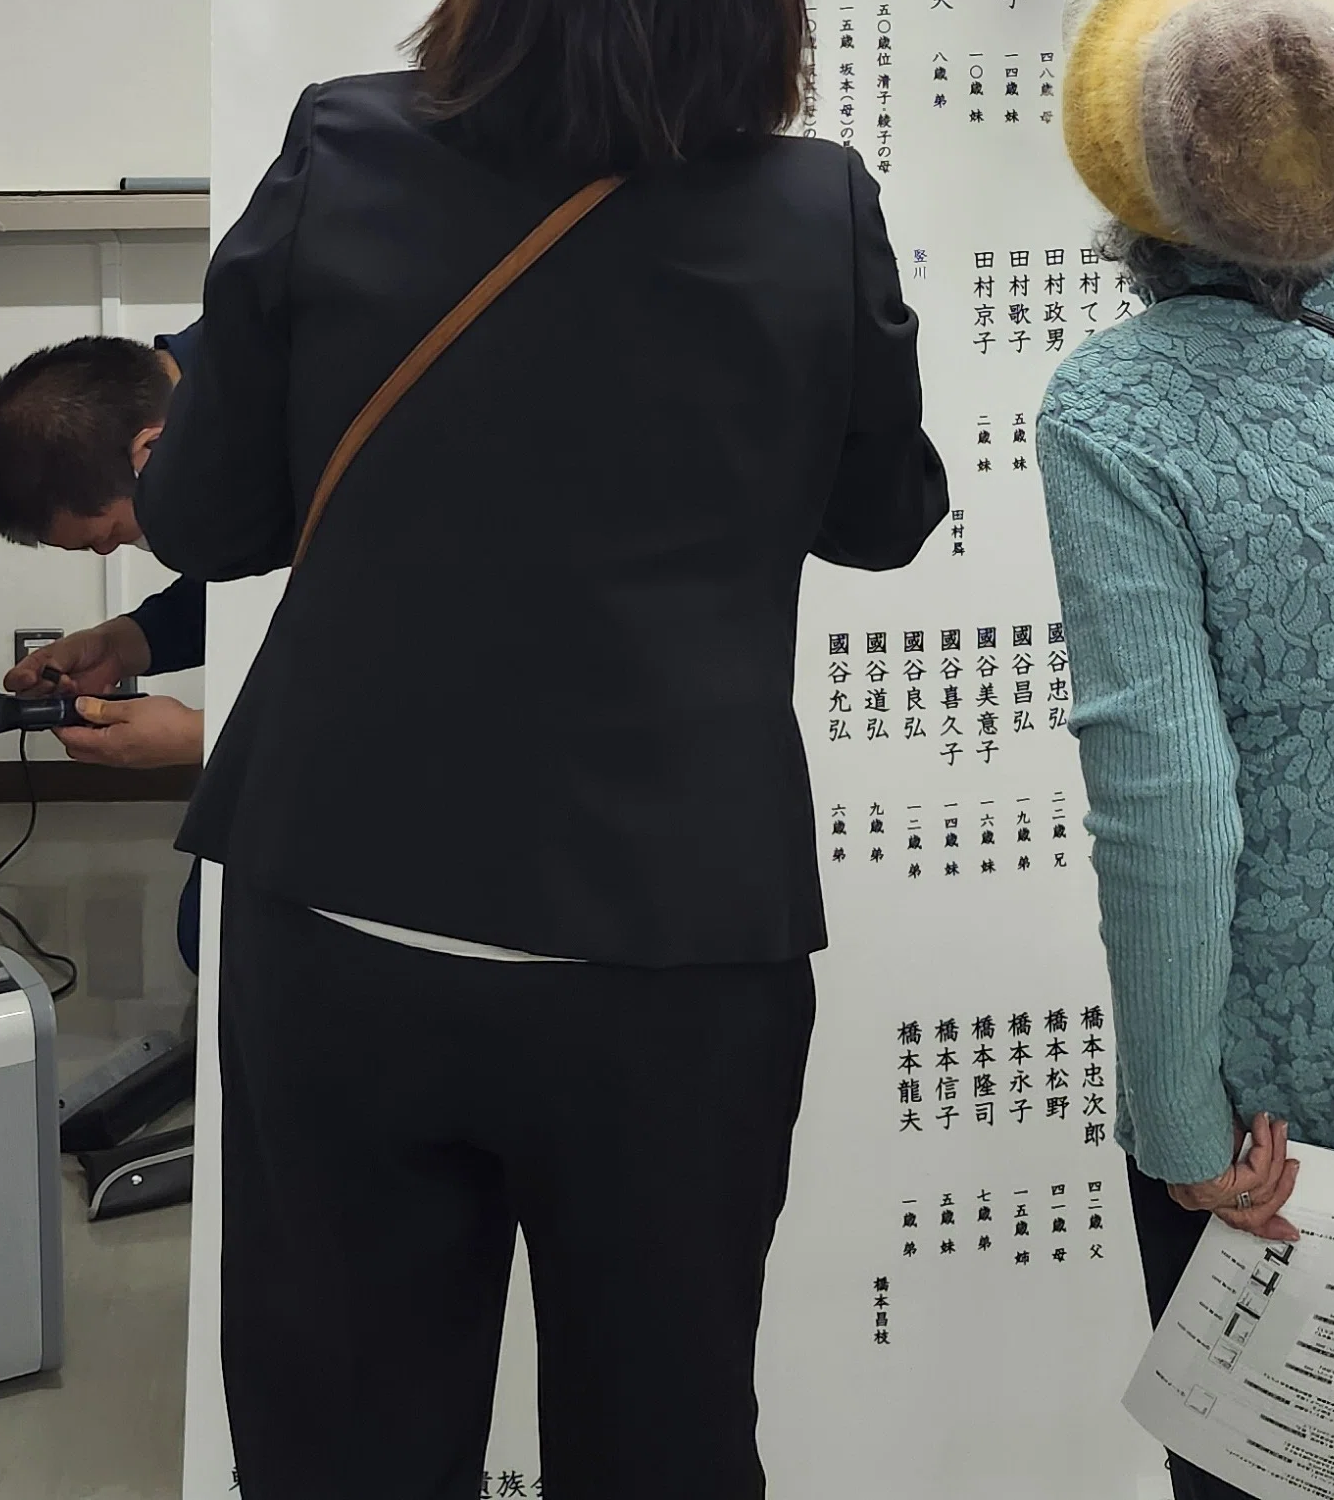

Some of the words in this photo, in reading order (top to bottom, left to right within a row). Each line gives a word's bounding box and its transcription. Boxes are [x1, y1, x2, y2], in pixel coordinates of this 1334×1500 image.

[973, 252, 996, 354] 田村京子
[1008, 251, 1031, 353] 田村歌子
[1043, 249, 1067, 351] 田村政男
[828, 633, 852, 741] 國谷允弘
[865, 632, 890, 740] 國谷道弘
[903, 630, 927, 739] 國谷良弘
[940, 629, 963, 766] 國谷喜久子
[975, 627, 999, 764] 國谷美意子
[1012, 625, 1034, 733] 國谷昌弘
[897, 1020, 923, 1132] 橋本龍夫
[935, 1018, 959, 1130] 橋本信子
[971, 1015, 997, 1126] 橋本隆司
[1008, 1012, 1033, 1124] 橋本永子
[1044, 1008, 1070, 1120] 橋本松野
[1080, 1006, 1106, 1146] 橋本忠次郎
